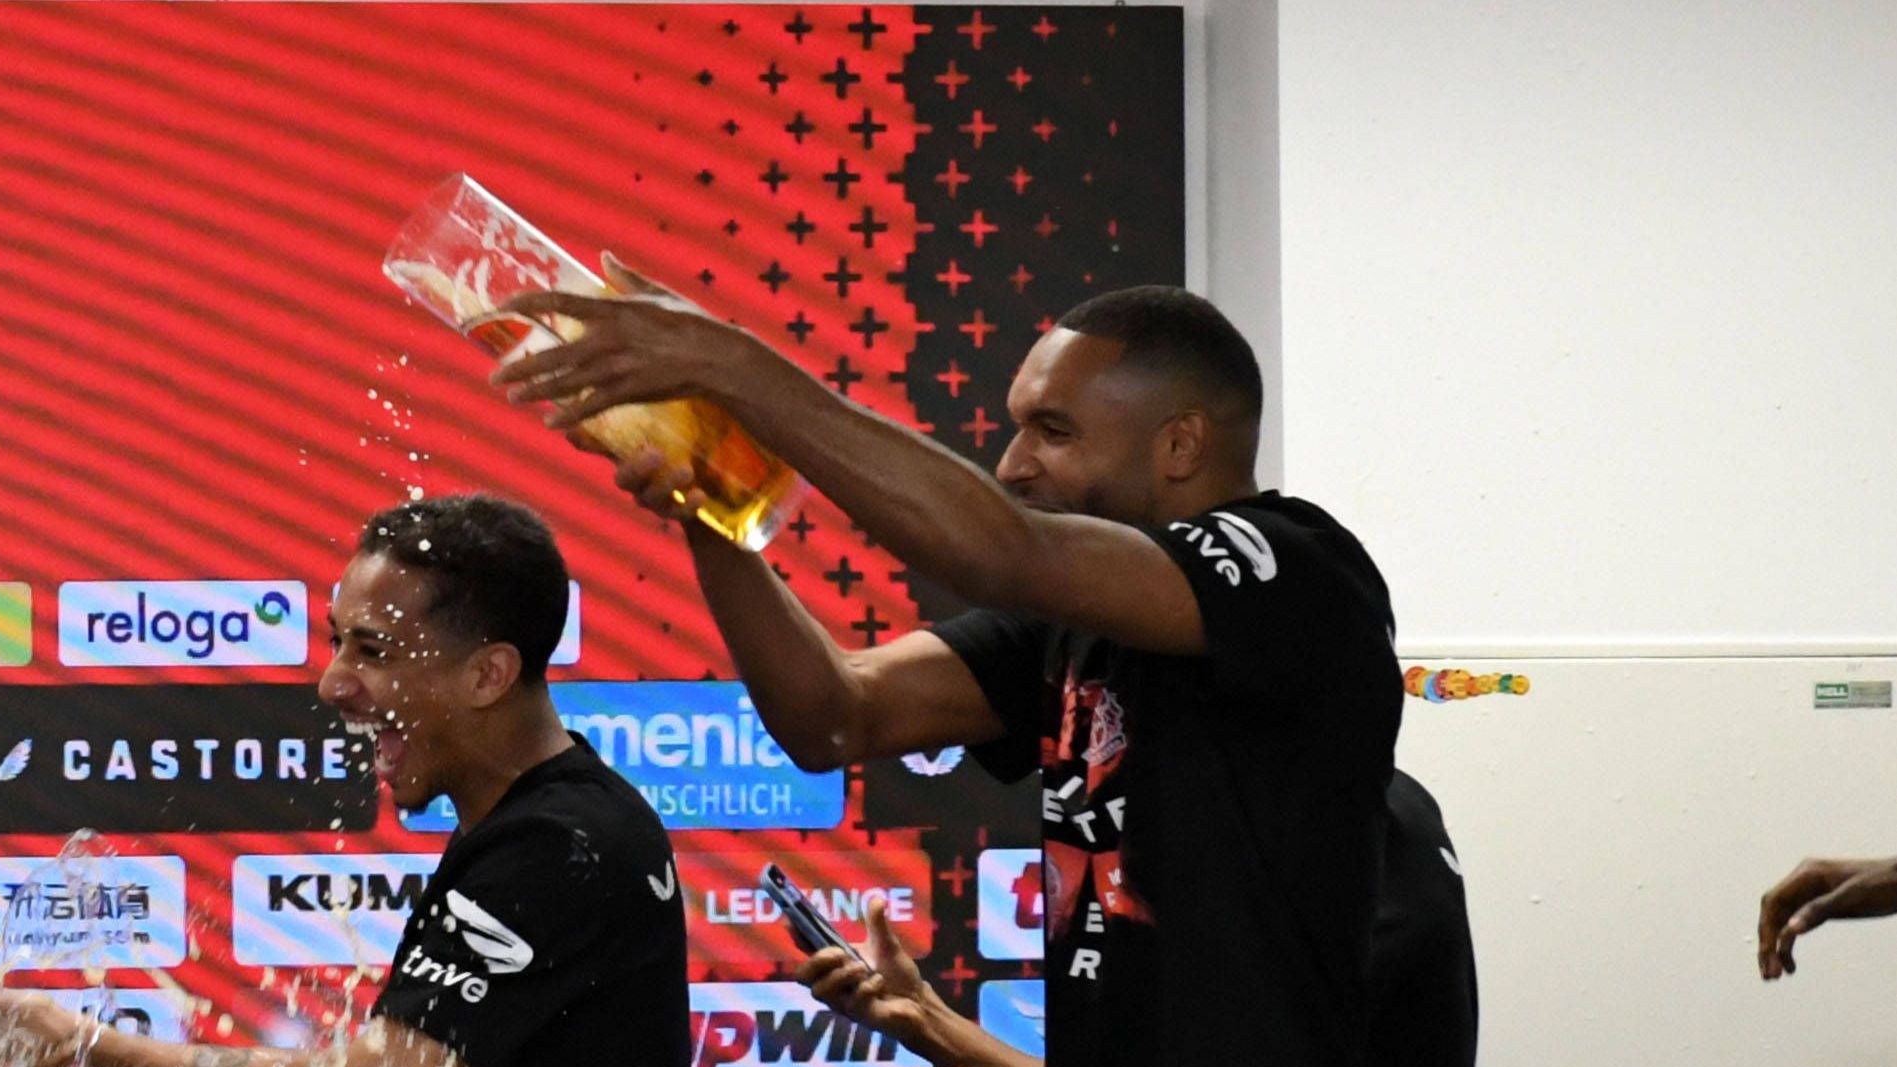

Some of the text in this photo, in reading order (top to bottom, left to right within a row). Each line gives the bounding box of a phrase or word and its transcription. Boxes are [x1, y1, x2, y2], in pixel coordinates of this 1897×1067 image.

[87, 592, 250, 658] reloga
[63, 739, 347, 780] CASTORE
[268, 874, 430, 911] KUM
[706, 888, 914, 924] LEDANCE
[401, 943, 489, 1003] trive
